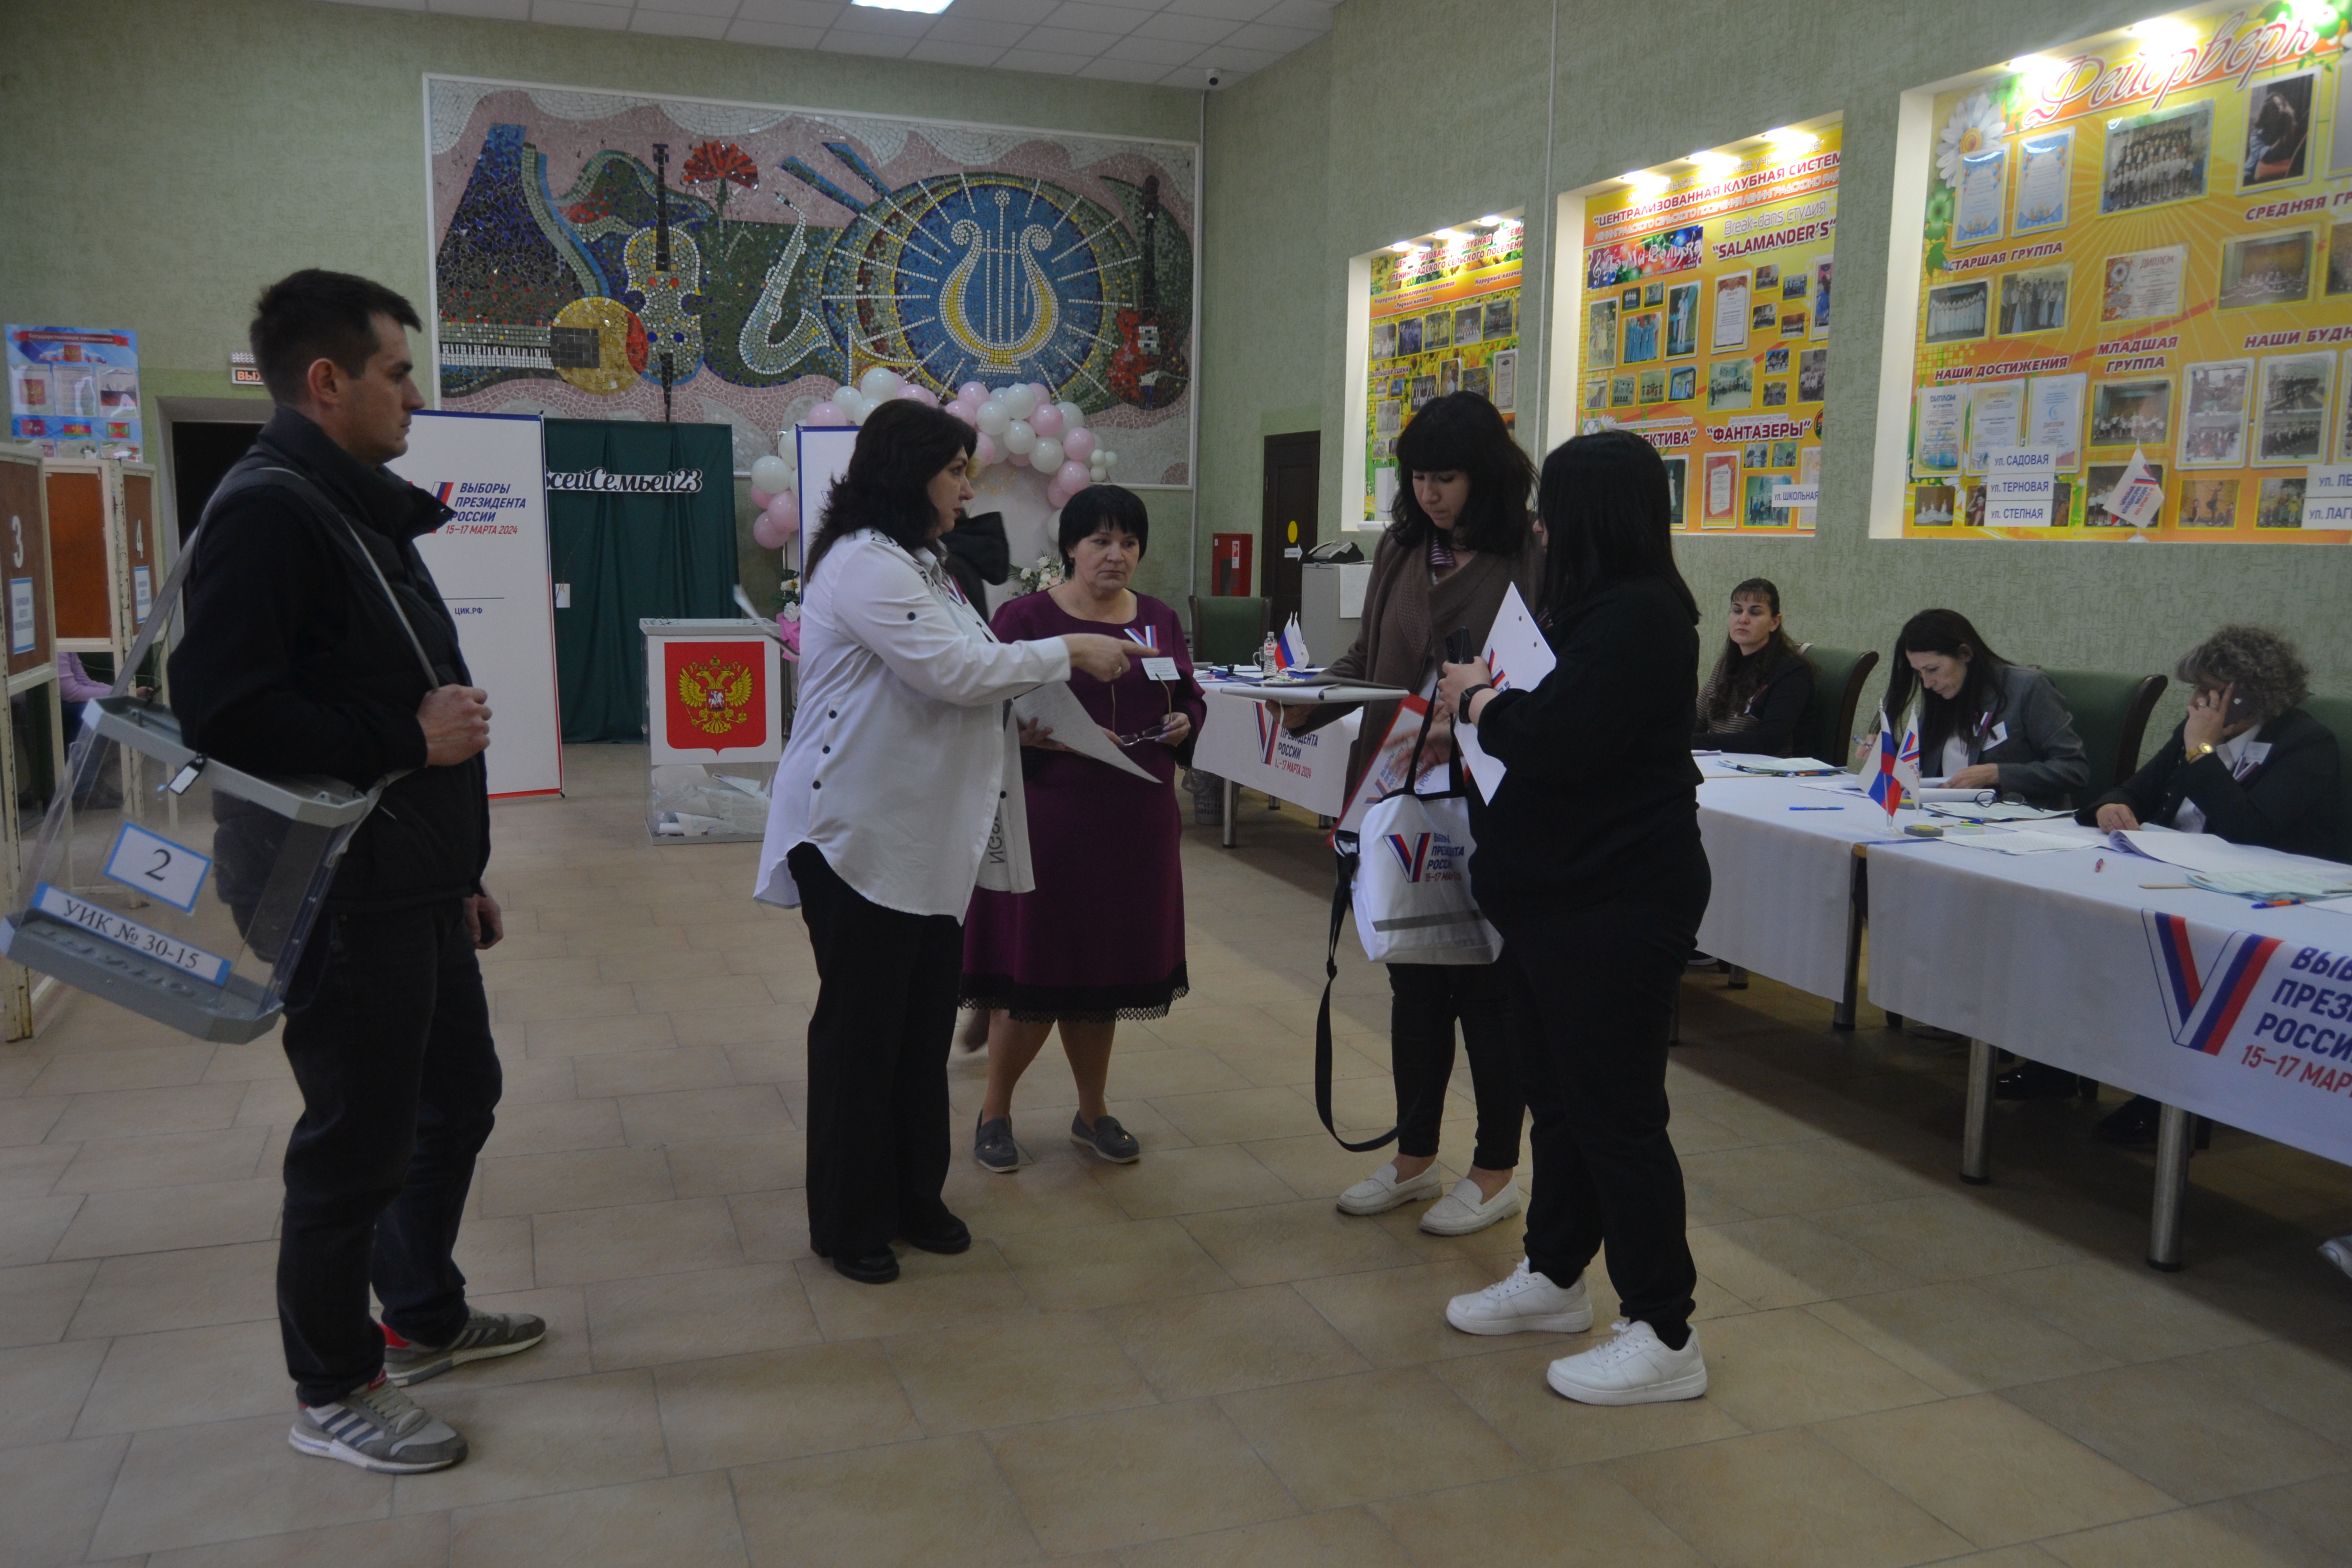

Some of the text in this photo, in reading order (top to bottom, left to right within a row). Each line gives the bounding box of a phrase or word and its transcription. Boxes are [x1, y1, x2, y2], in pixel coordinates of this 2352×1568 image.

[1724, 167, 1785, 193] КЛУБНАЯ
[2245, 196, 2327, 220] СРЕДНЯЯ
[1724, 201, 1826, 236] Break-dans студия
[1461, 234, 1491, 250] КЛУБНАЯ
[1948, 242, 2063, 271] СТАРШАЯ ГРУППА
[2140, 255, 2174, 270] ДИПЛОМ
[1391, 261, 1446, 281] ЛЕНИНГРАДСКОГО
[1448, 250, 1485, 267] СЕЛЬСКОГО
[1475, 273, 1501, 286] Народный
[1374, 293, 1396, 305] Народный
[2097, 336, 2178, 355] МЛАДШАЯ
[2244, 332, 2301, 349] НАШИ
[1934, 357, 2068, 380] НАШИ ДОСТИЖЕНИЯ
[2105, 356, 2165, 373] ГРУППА
[2006, 454, 2049, 467] САДОВАЯ
[459, 483, 511, 494] ВЫБОРЫ
[1991, 481, 2049, 493] ул. ТЕРНОВАЯ
[2319, 477, 2333, 487] ул.
[454, 497, 527, 509] ПРЕЗИДЕНТА
[1783, 491, 1818, 501] ШКОЛЬНАЯ
[450, 511, 496, 522] РОССИИ
[1991, 508, 2043, 519] ул. СТЕПНАЯ
[2309, 510, 2323, 519] ул.
[470, 525, 497, 534] МАРТА
[498, 526, 518, 534] 2024
[12, 516, 23, 569] 3
[136, 519, 143, 558] 4
[1380, 751, 1395, 778] ВЫБОРЫ
[144, 849, 172, 881] 2
[64, 900, 200, 969] УИК № 30-15
